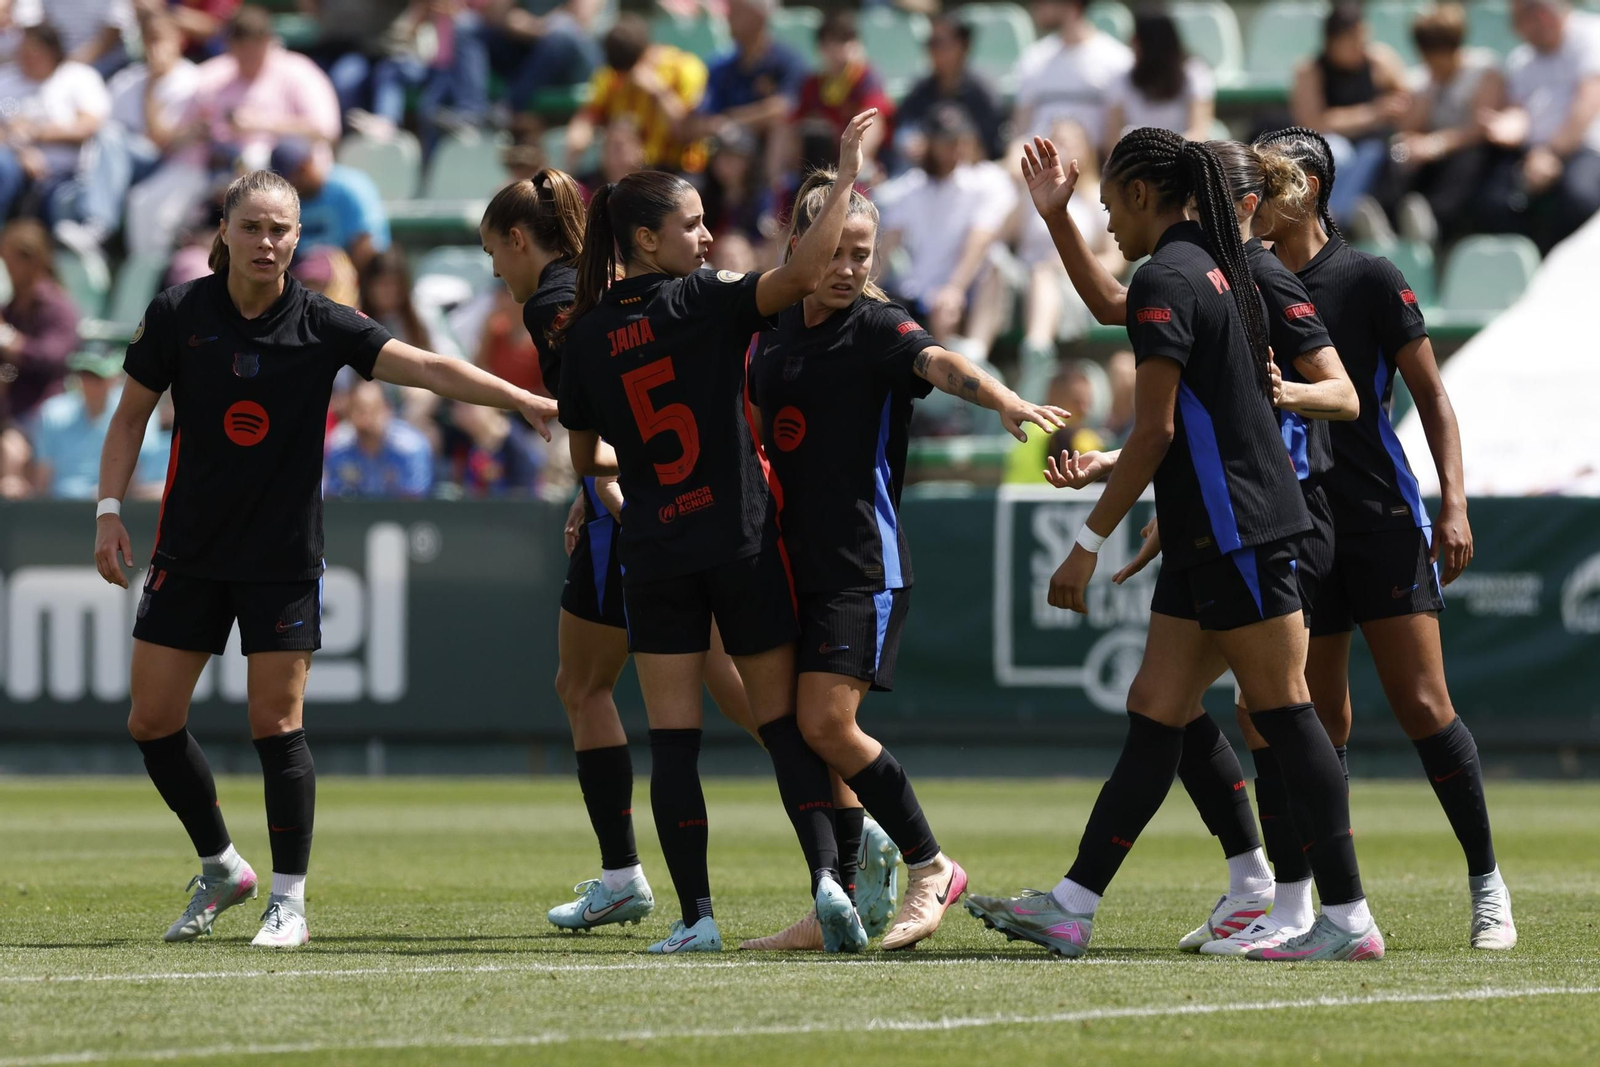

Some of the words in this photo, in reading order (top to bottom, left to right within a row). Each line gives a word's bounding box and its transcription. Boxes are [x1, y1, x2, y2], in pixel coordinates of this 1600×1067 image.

[606, 316, 655, 357] JANA
[620, 355, 700, 486] 5
[675, 486, 711, 505] UNHCR
[678, 494, 714, 513] ACNUR
